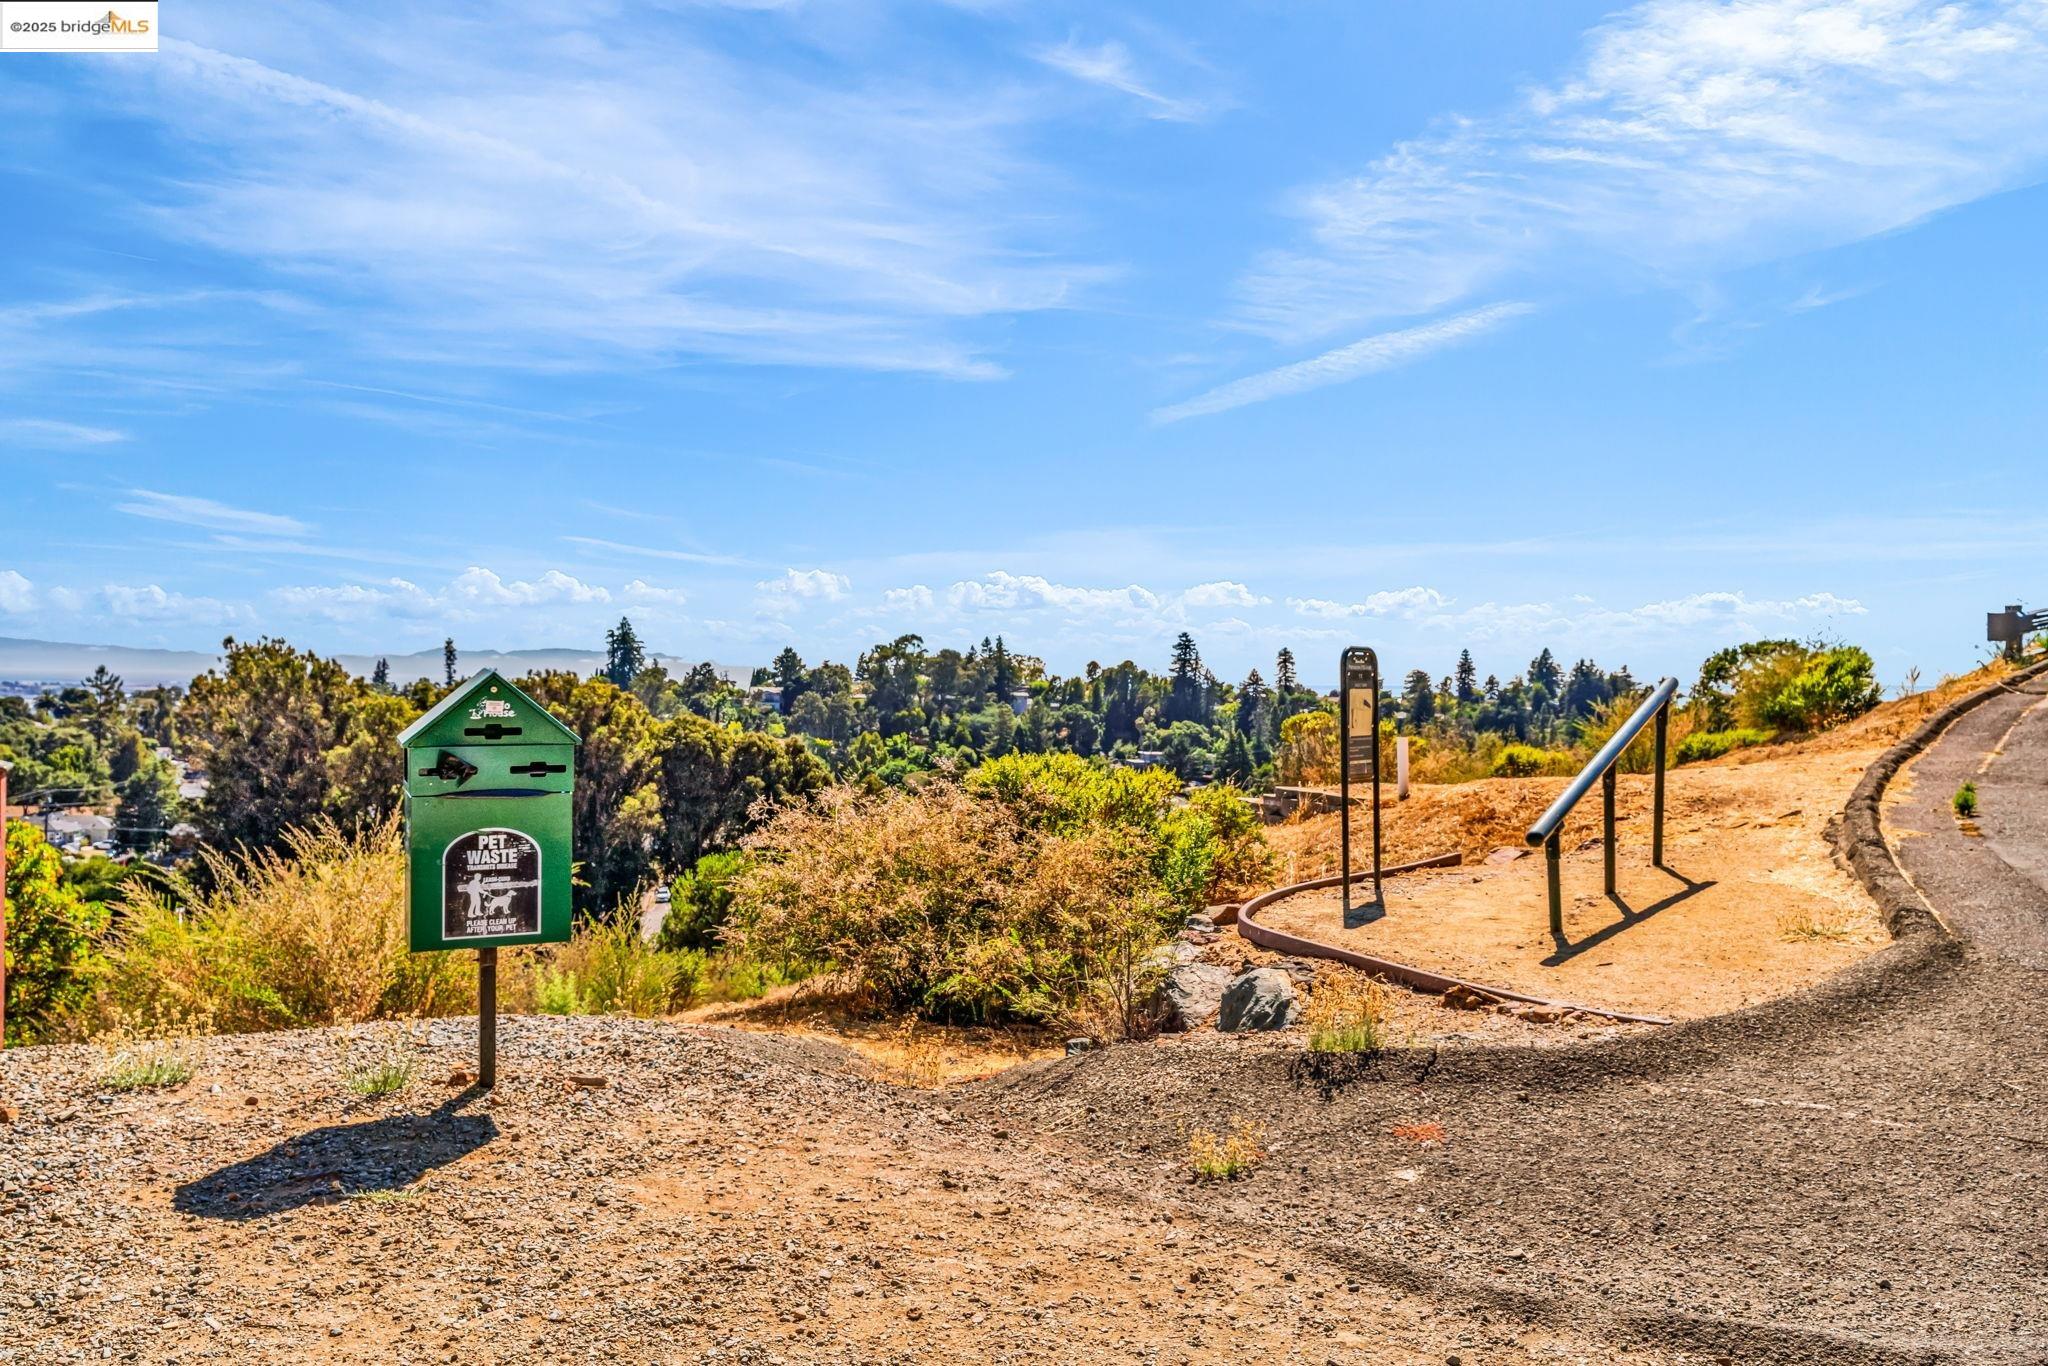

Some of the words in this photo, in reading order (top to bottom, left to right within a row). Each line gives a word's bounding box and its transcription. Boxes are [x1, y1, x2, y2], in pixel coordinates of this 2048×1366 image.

[478, 834, 507, 849] PET
[466, 848, 518, 865] WASTE
[466, 919, 488, 927] PLEASE
[489, 918, 508, 926] CLEAN
[508, 917, 517, 925] UP
[466, 925, 486, 934] AFTER
[487, 924, 504, 932] YOUR
[505, 923, 517, 932] PET
